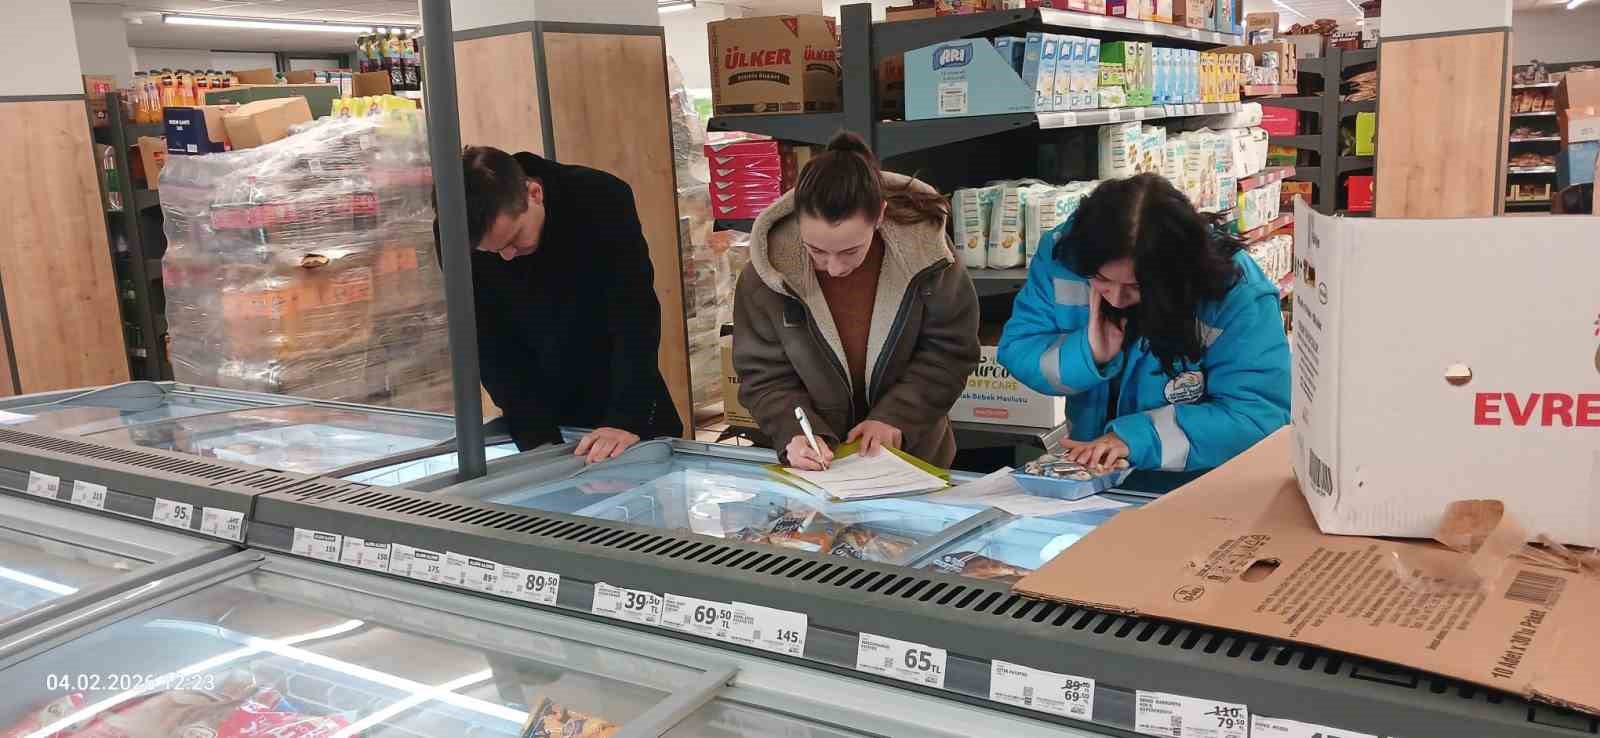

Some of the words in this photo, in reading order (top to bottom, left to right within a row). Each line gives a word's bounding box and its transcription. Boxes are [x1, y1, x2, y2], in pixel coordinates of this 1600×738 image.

[725, 46, 792, 70] ÜLKER
[940, 48, 965, 66] ARI
[174, 505, 187, 520] 95
[776, 628, 799, 643] 145
[904, 648, 932, 672] 65
